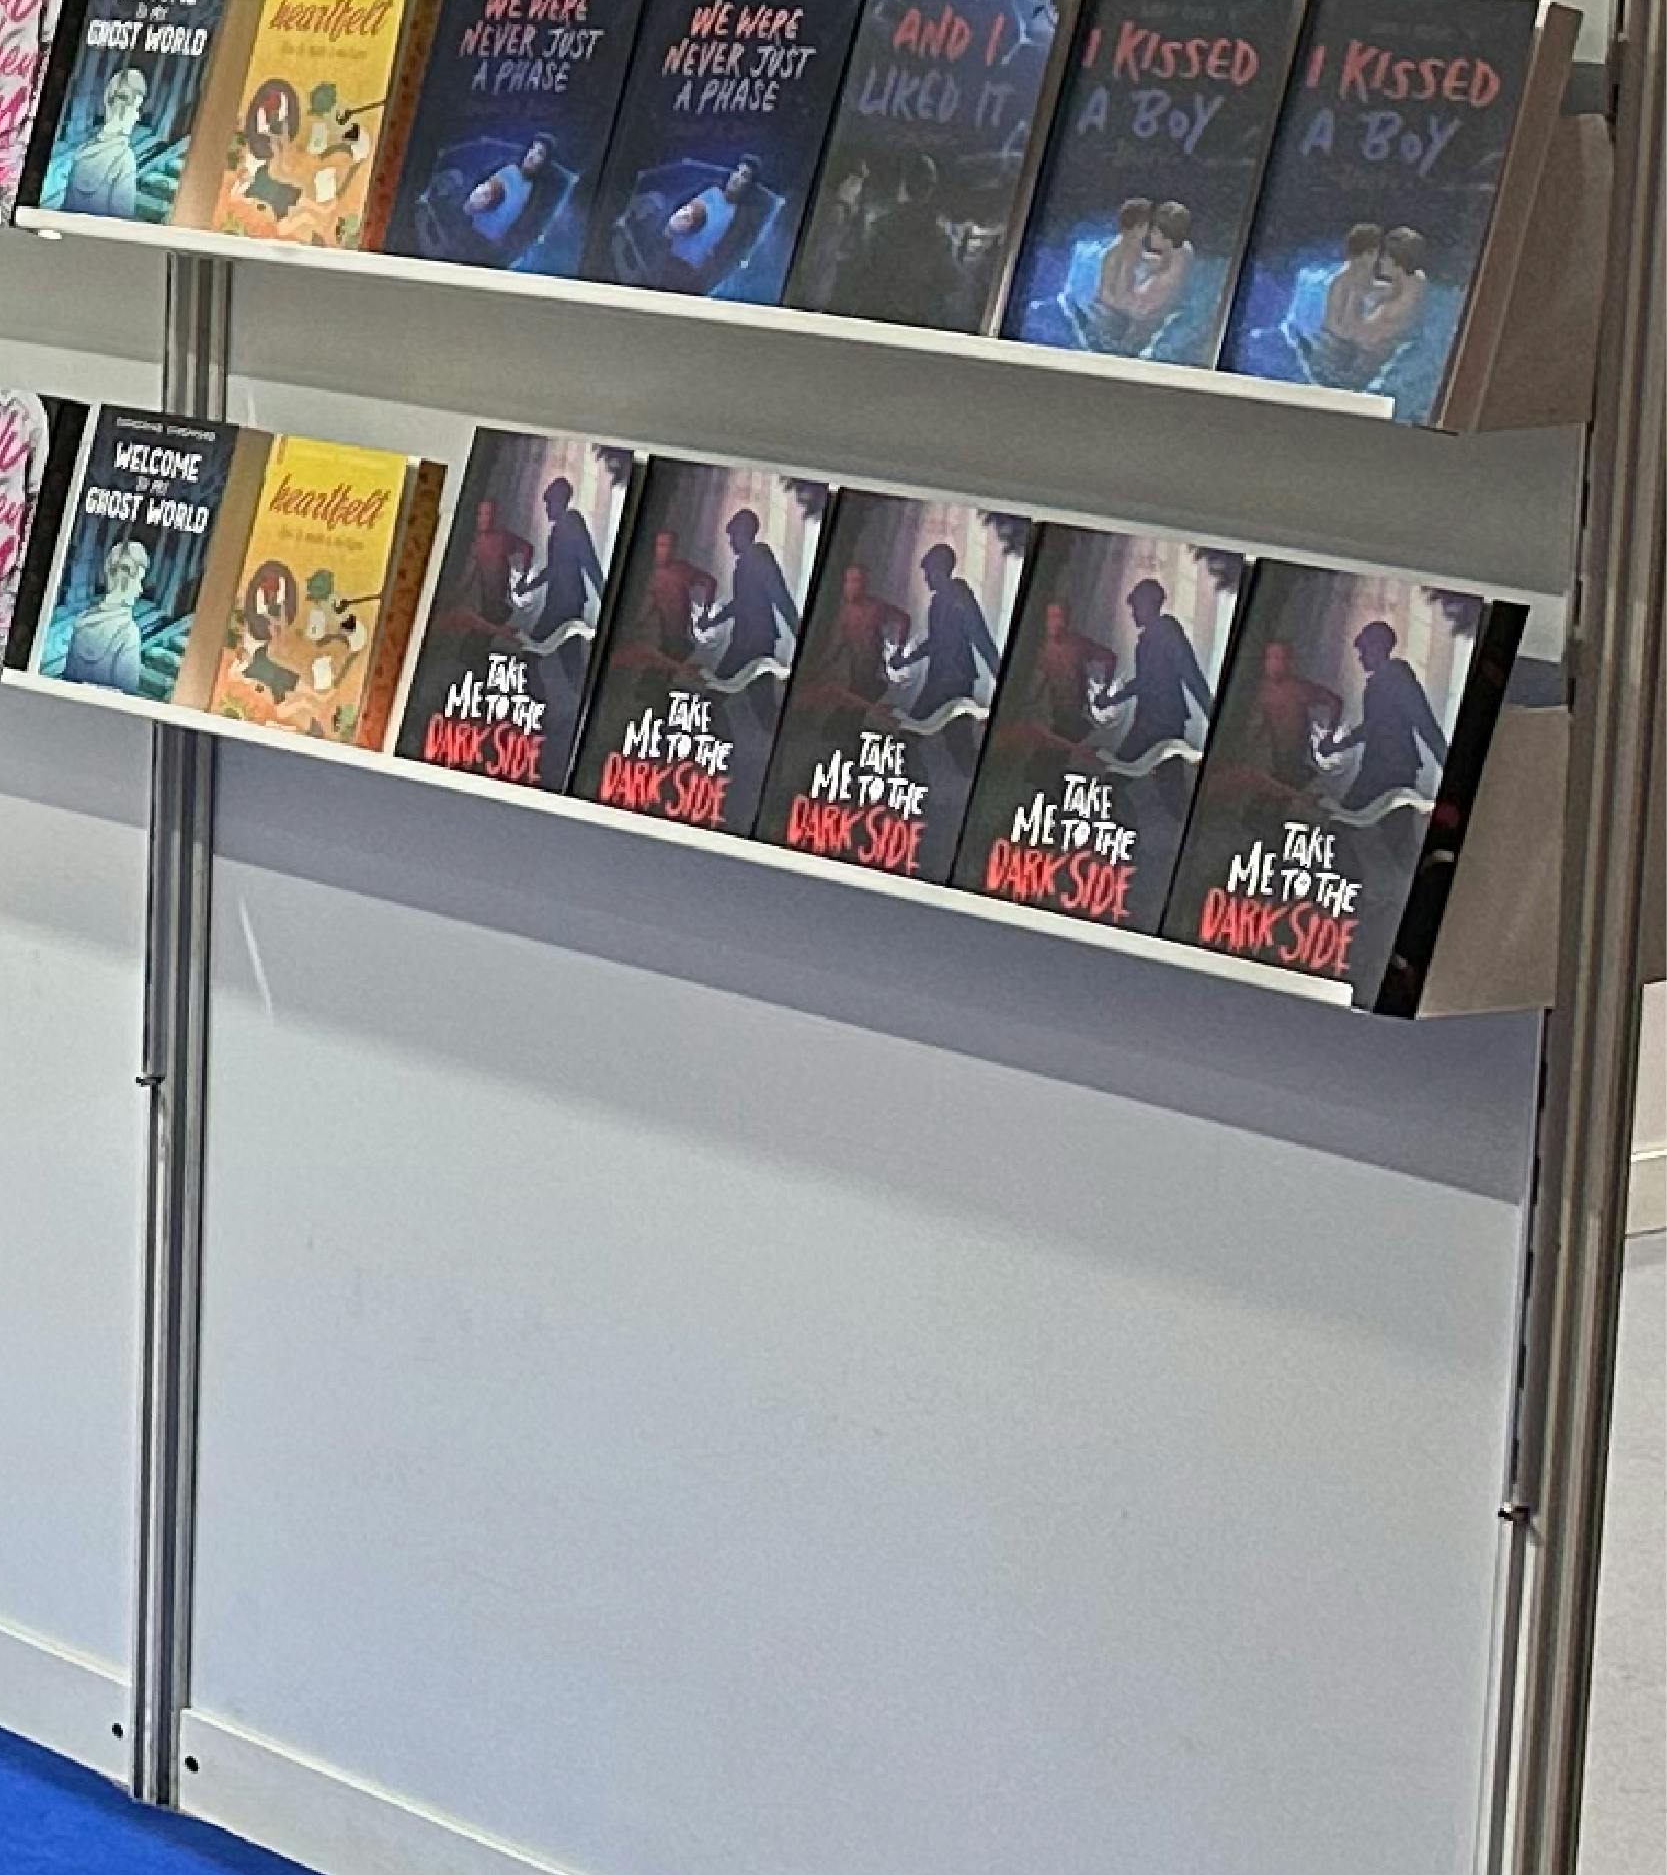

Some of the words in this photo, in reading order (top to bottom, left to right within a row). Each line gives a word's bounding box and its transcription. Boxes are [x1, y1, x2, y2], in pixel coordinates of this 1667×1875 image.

[459, 22, 538, 63] NEVER
[542, 26, 604, 63] JUST
[1114, 19, 1261, 88] KISSED
[471, 61, 491, 94] A
[492, 59, 571, 95] PHASE
[1077, 87, 1108, 133] A
[269, 474, 394, 529] heartfelt
[1283, 819, 1337, 868] TAKE
[1226, 840, 1278, 897] ME
[1280, 867, 1311, 899] TO
[1315, 870, 1364, 917] THE
[1198, 886, 1279, 964] DARK
[1279, 899, 1359, 976] SIDE
